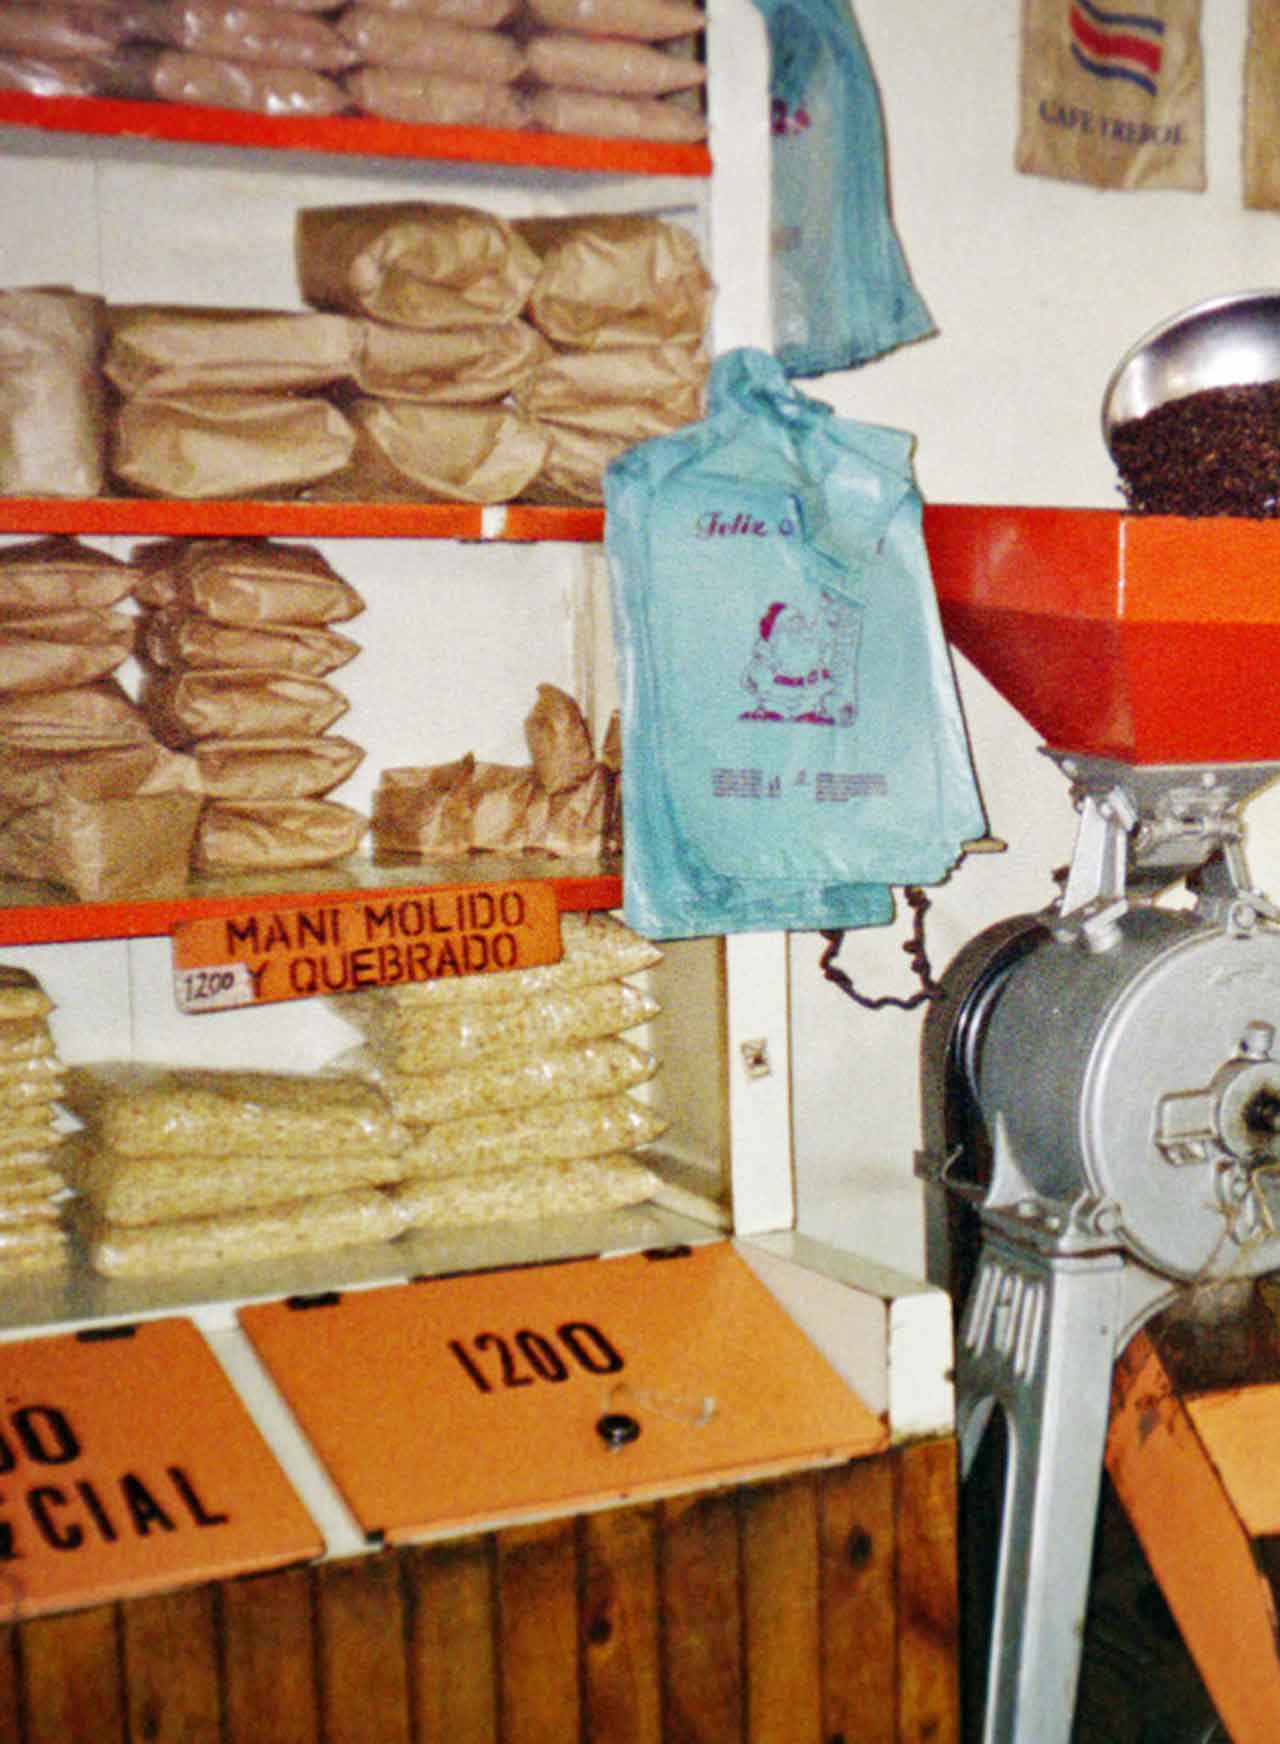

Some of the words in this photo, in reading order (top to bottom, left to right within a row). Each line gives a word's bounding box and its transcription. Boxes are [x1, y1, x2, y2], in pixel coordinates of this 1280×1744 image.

[225, 907, 340, 957] MANI
[364, 890, 526, 940] MOLIDO
[184, 970, 236, 1002] 1200
[244, 959, 269, 999] Y
[288, 931, 518, 994] QUEBRADO
[448, 1321, 625, 1395] 1200
